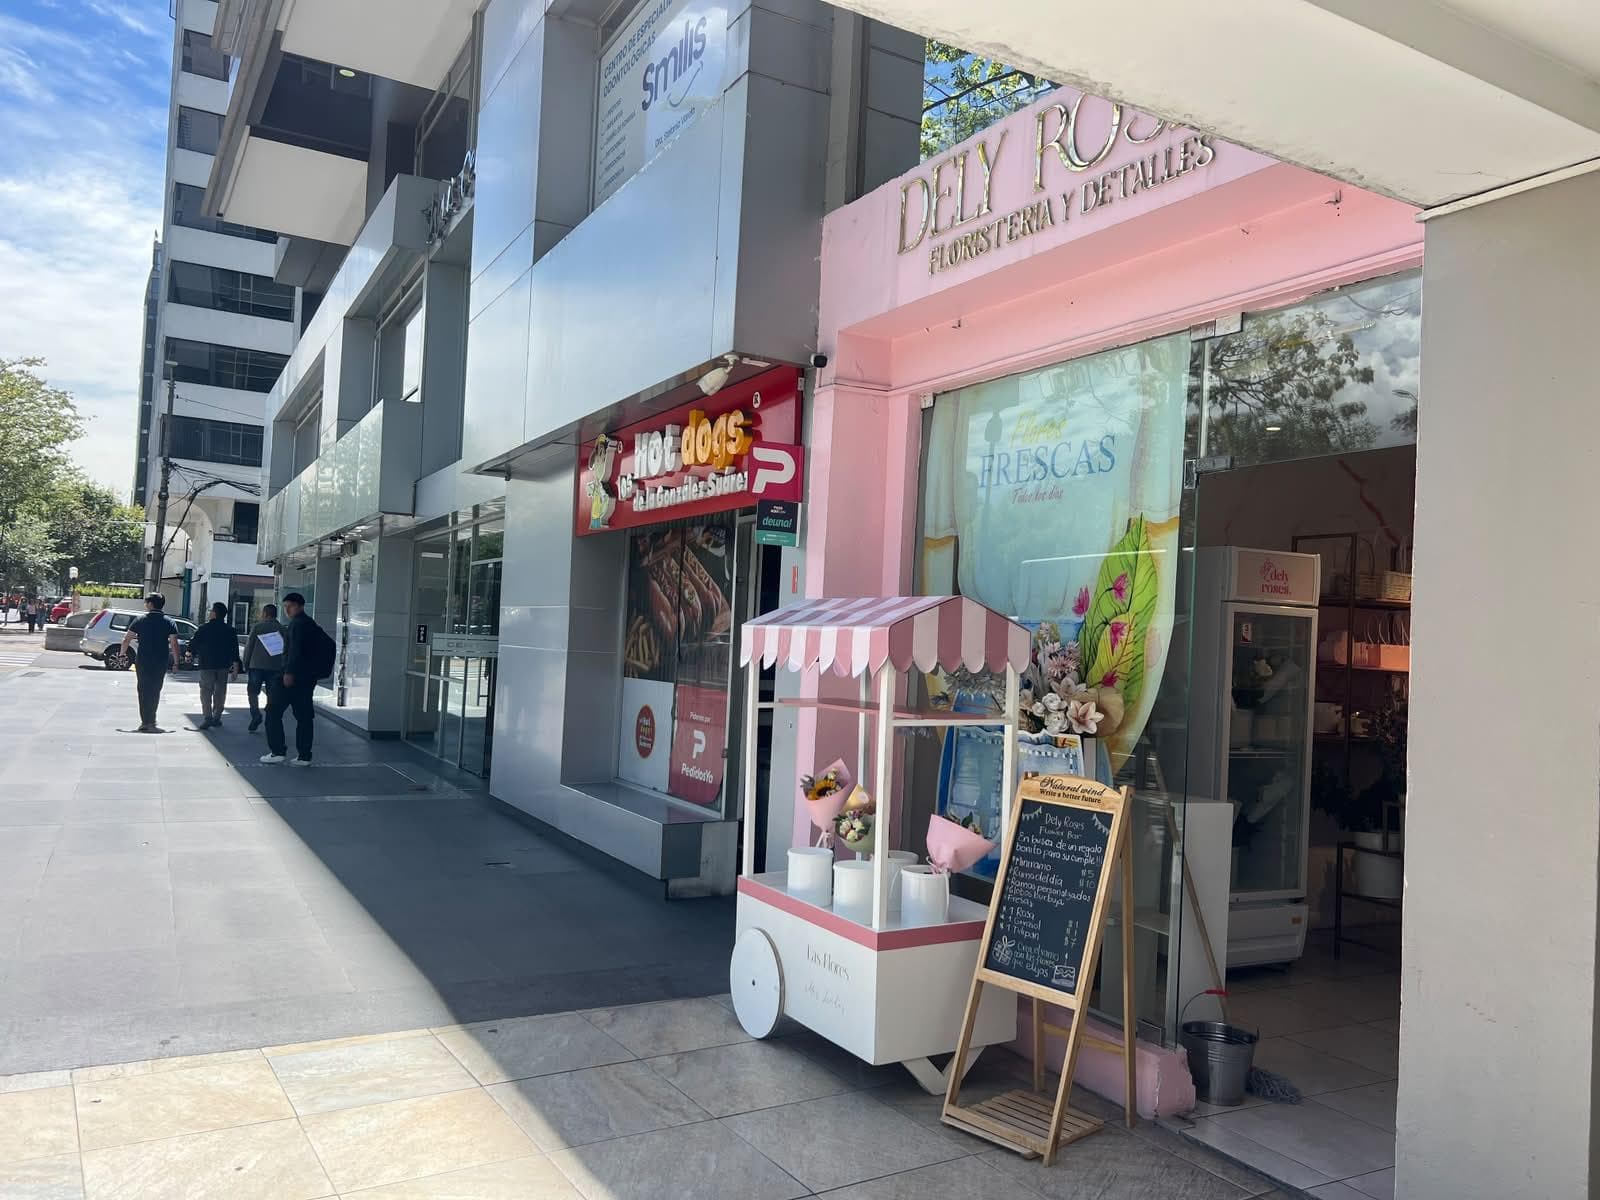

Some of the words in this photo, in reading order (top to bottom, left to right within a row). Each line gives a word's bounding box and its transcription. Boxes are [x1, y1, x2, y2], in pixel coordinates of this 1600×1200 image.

[603, 46, 628, 79] CENTRO
[897, 129, 1008, 255] DELY
[927, 197, 1055, 277] FLORISTERIA
[1060, 189, 1075, 222] Y
[1080, 134, 1216, 217] DETALLES
[681, 409, 750, 470] dogs
[978, 434, 1116, 489] FRESCAS
[681, 763, 714, 784] PedidosYa
[1040, 776, 1082, 794] Natural
[1080, 786, 1107, 797] wind
[1040, 788, 1057, 797] Write
[1062, 791, 1081, 801] better
[1081, 794, 1102, 804] future
[1045, 812, 1062, 830] Dely
[1017, 831, 1030, 843] En
[1032, 834, 1053, 847] busca
[1055, 839, 1067, 850] de
[1068, 844, 1077, 852] un
[1078, 844, 1103, 858] regalo
[1067, 830, 1082, 840] Bar
[1015, 842, 1042, 855] bonito
